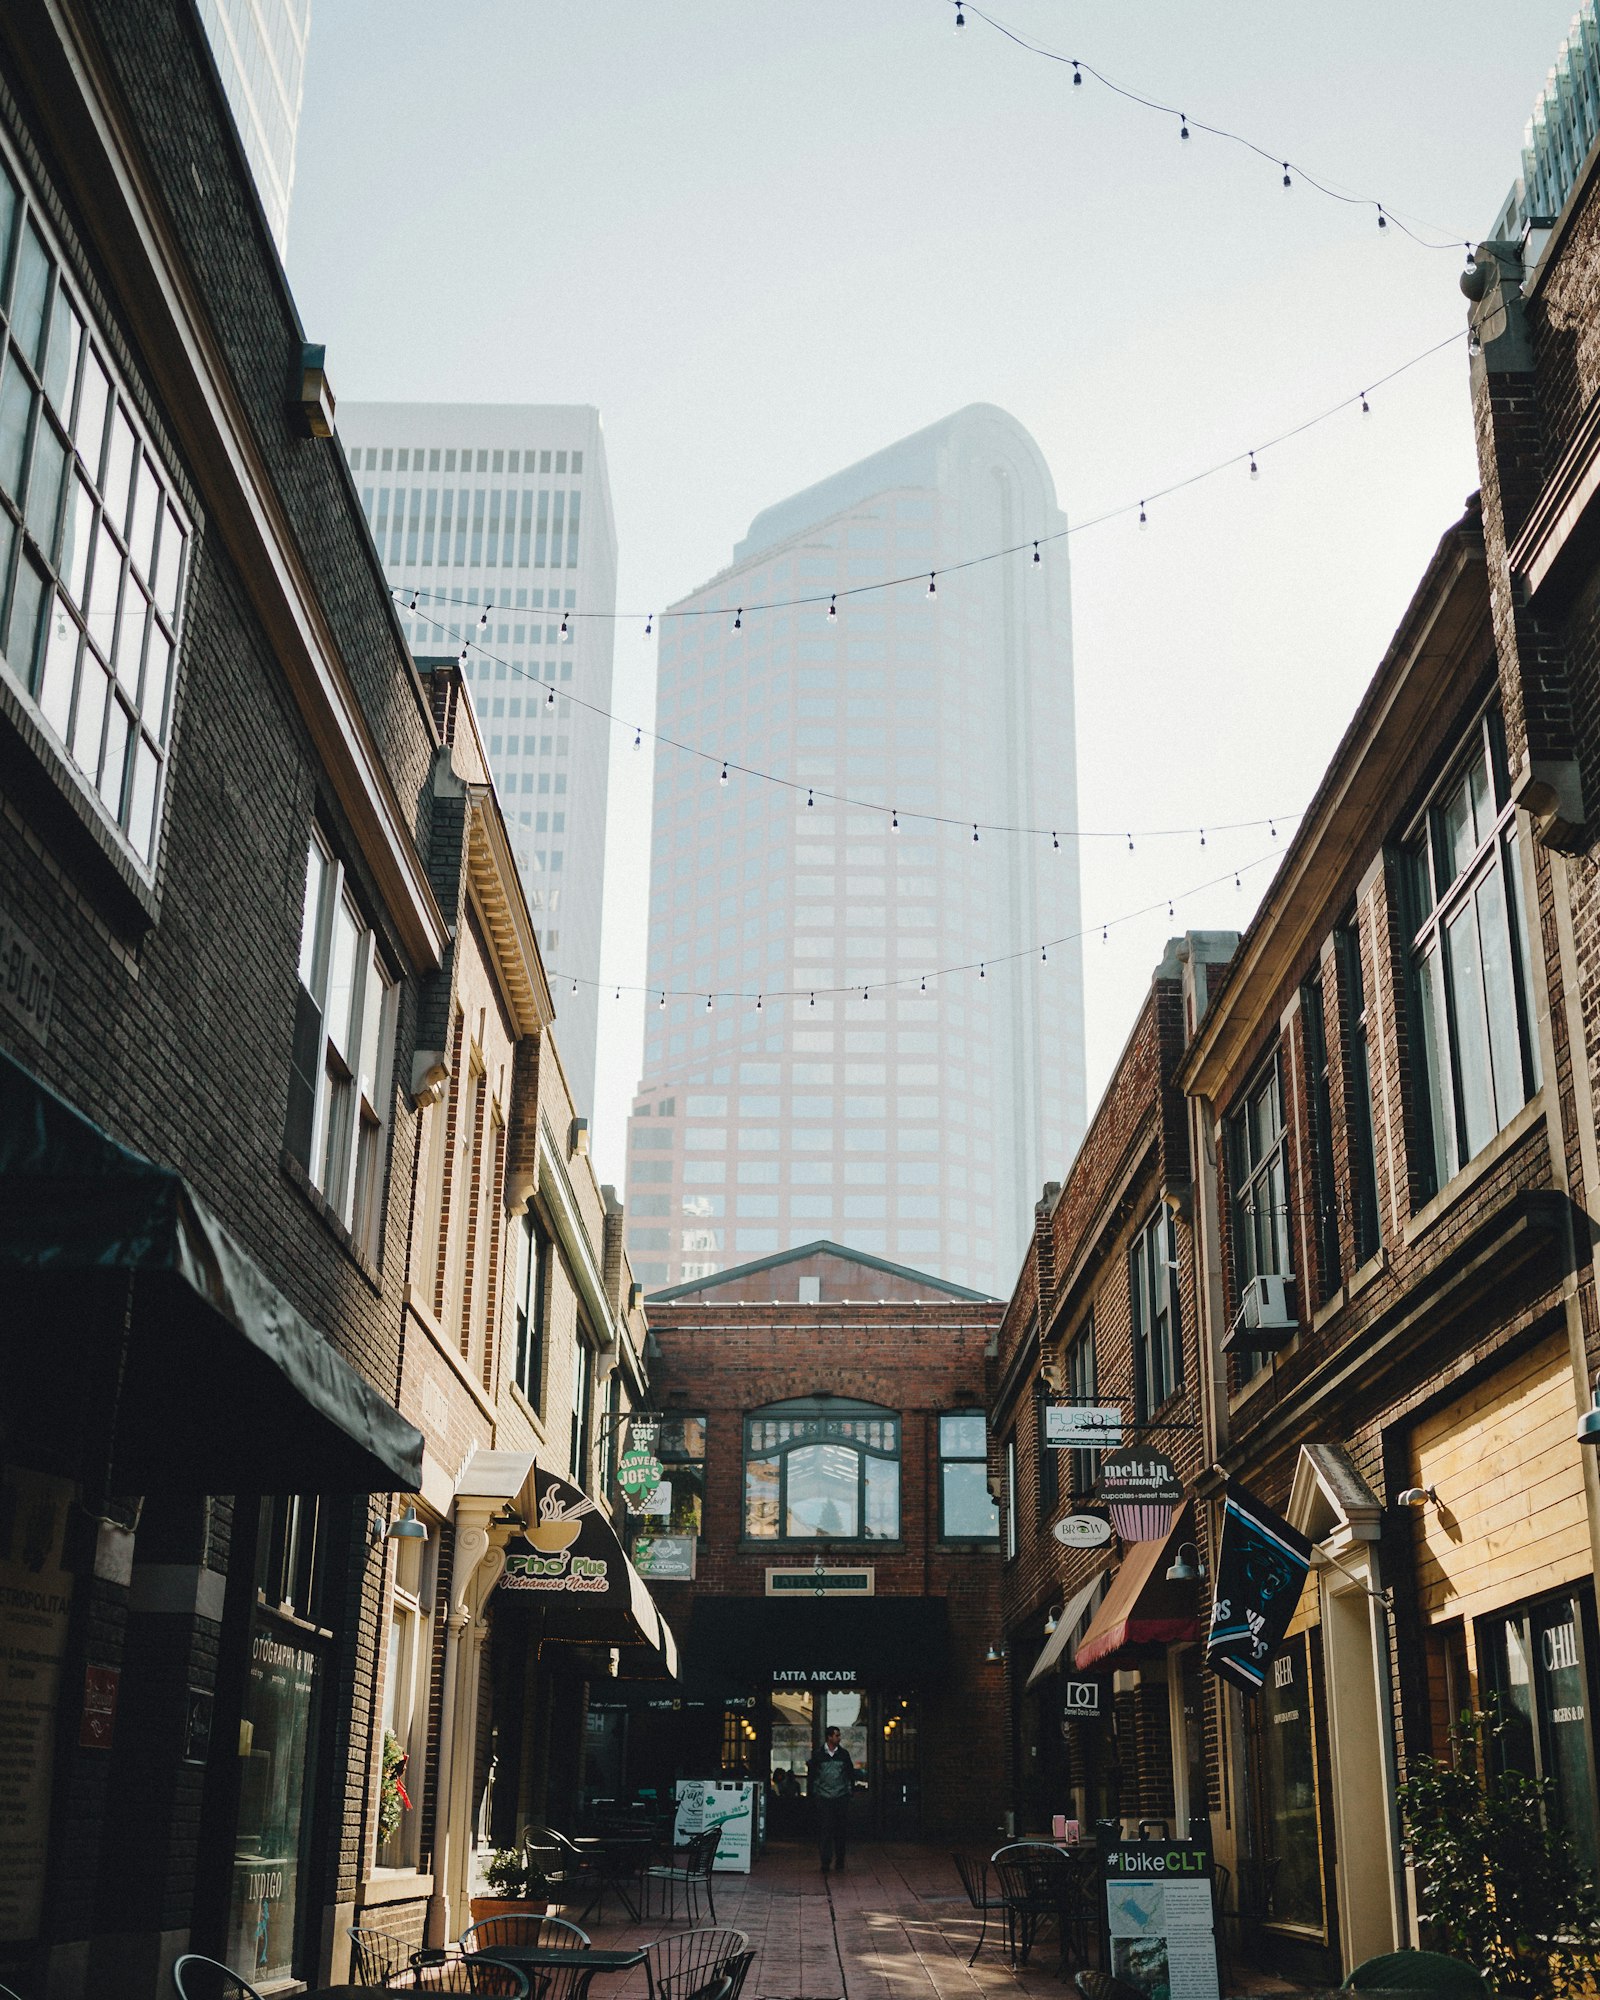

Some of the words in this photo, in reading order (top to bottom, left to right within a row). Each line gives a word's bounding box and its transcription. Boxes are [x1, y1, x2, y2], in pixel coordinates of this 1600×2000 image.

[633, 1440, 648, 1452] AT
[620, 1456, 658, 1469] CLOVER
[619, 1467, 661, 1486] JOE'S
[572, 1557, 607, 1576] Plus
[500, 1575, 565, 1591] Vietnamese
[565, 1575, 609, 1592] Noodle
[296, 1649, 302, 1670] &
[773, 1671, 807, 1681] LATTA
[810, 1671, 857, 1681] ARCADE
[1274, 1655, 1293, 1688] BEER
[1077, 1708, 1089, 1716] Davis
[1088, 1709, 1100, 1717] Salon
[731, 1804, 748, 1813] JOE'S
[1107, 1851, 1206, 1871] #ibikeCLT
[249, 1872, 282, 1900] INDIGO
